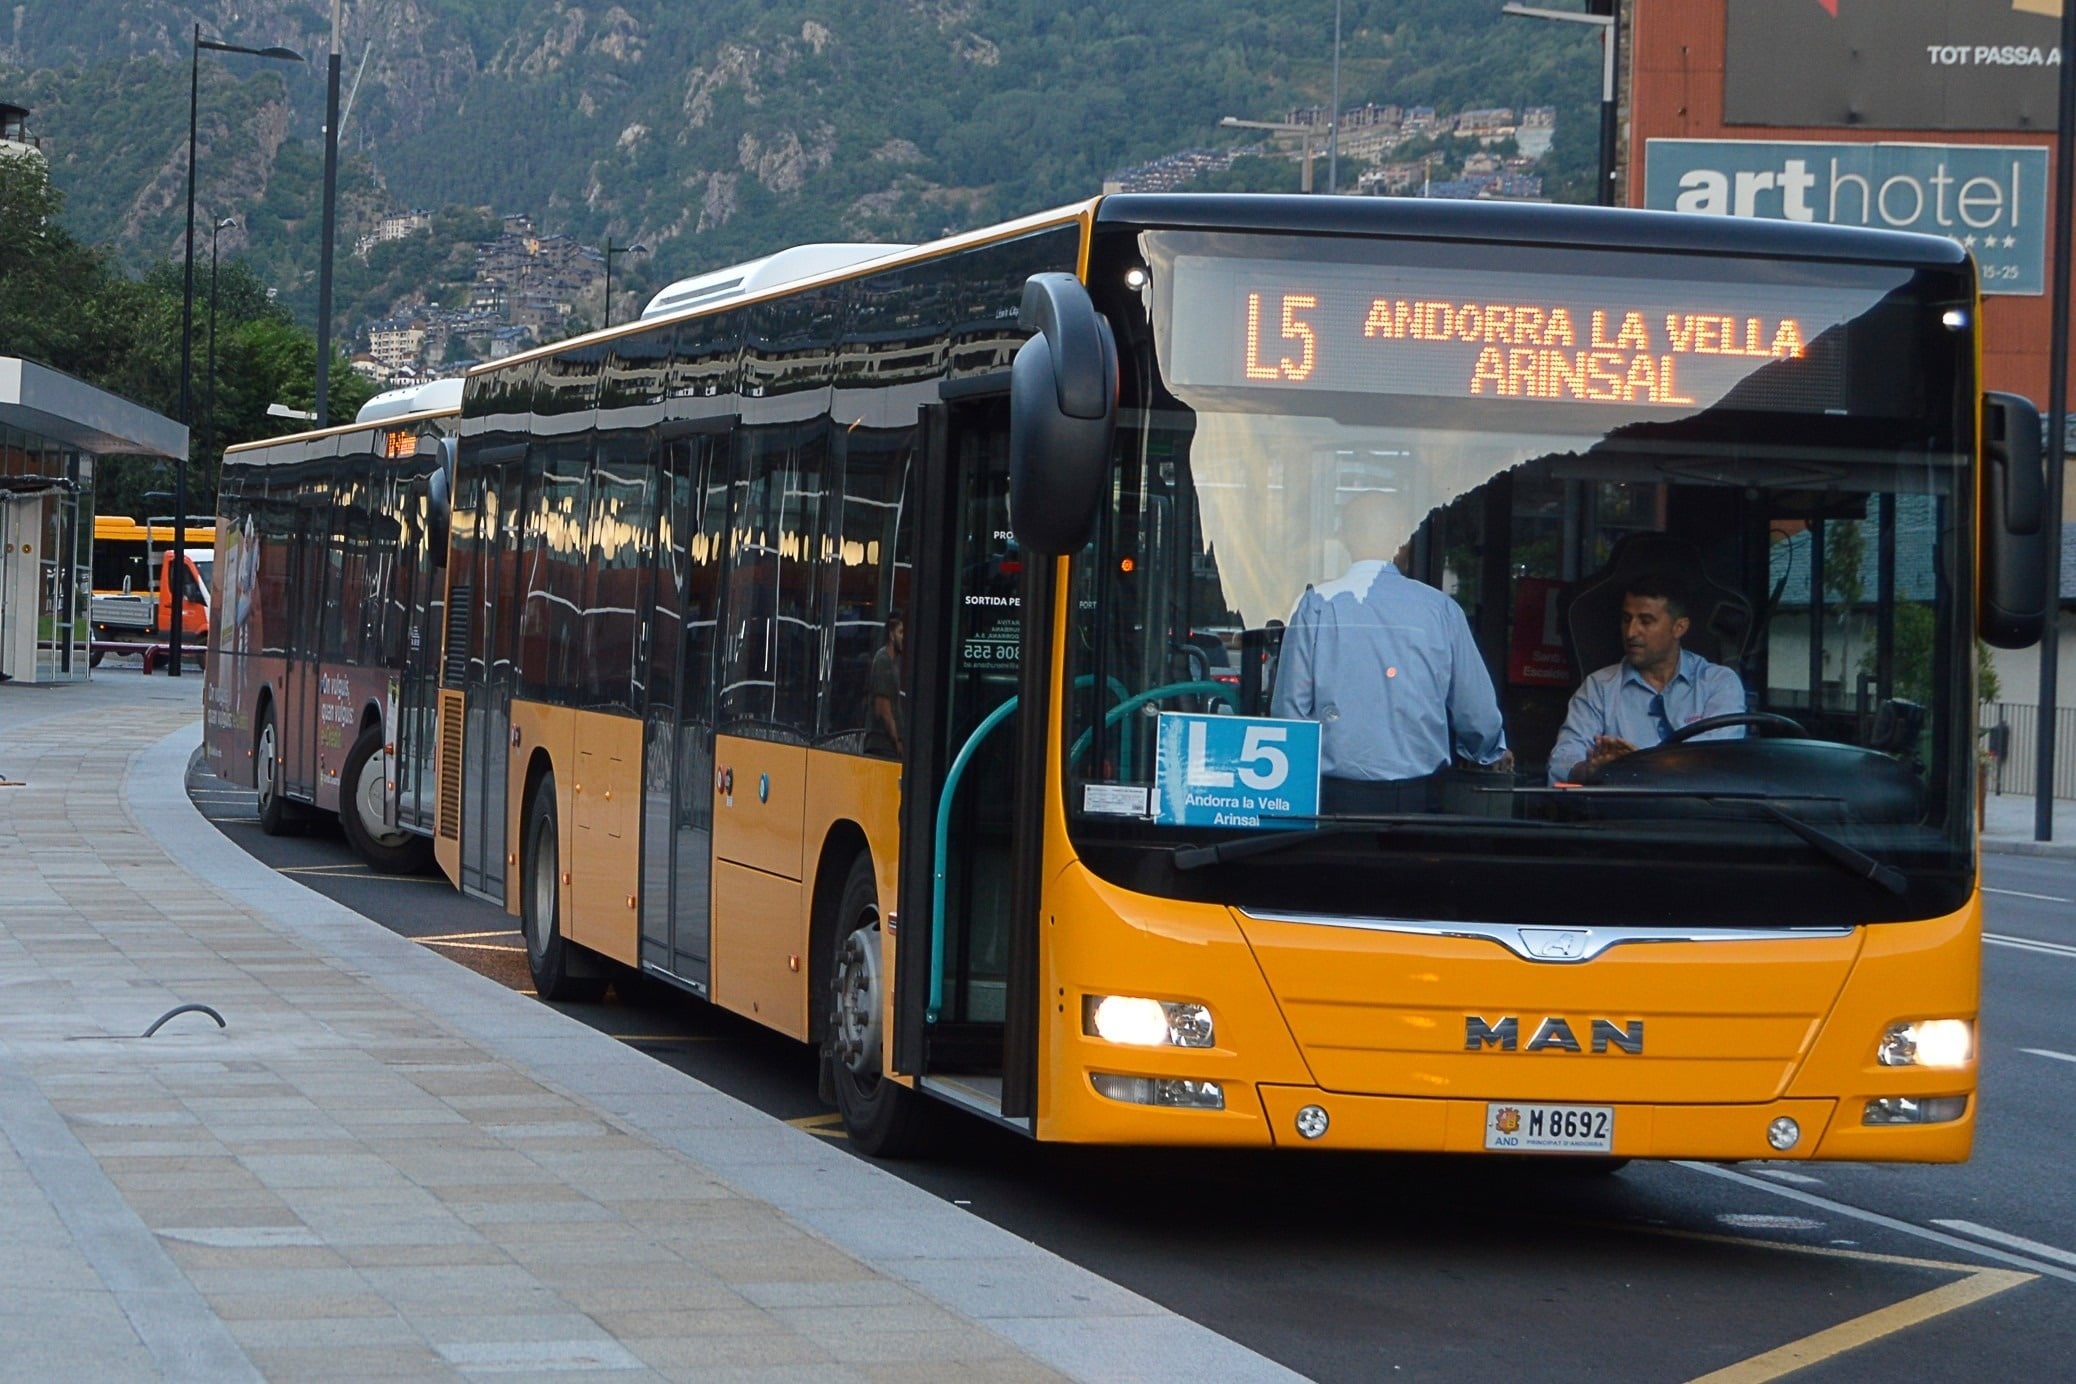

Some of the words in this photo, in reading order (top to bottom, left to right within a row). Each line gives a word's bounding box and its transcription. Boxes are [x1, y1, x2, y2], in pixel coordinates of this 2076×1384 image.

[1927, 46, 1971, 65] TOT
[1974, 46, 2043, 66] PASSA
[2046, 47, 2062, 67] A
[1246, 293, 1318, 381] L5
[1364, 298, 1574, 347] ANDORRA
[1590, 308, 1647, 351] LA
[1665, 313, 1804, 358] VELLA
[1469, 346, 1694, 405] ARINSAL
[964, 595, 1007, 606] SORTIDA
[1187, 721, 1289, 791] L5
[1184, 793, 1240, 808] Andorra
[1242, 796, 1254, 809] la
[1258, 797, 1290, 811] Vella
[1213, 812, 1260, 827] Arinsal
[1464, 1016, 1644, 1055] MAN
[1529, 1109, 1544, 1137] M
[1549, 1110, 1608, 1139] 8692
[1494, 1136, 1519, 1147] AND
